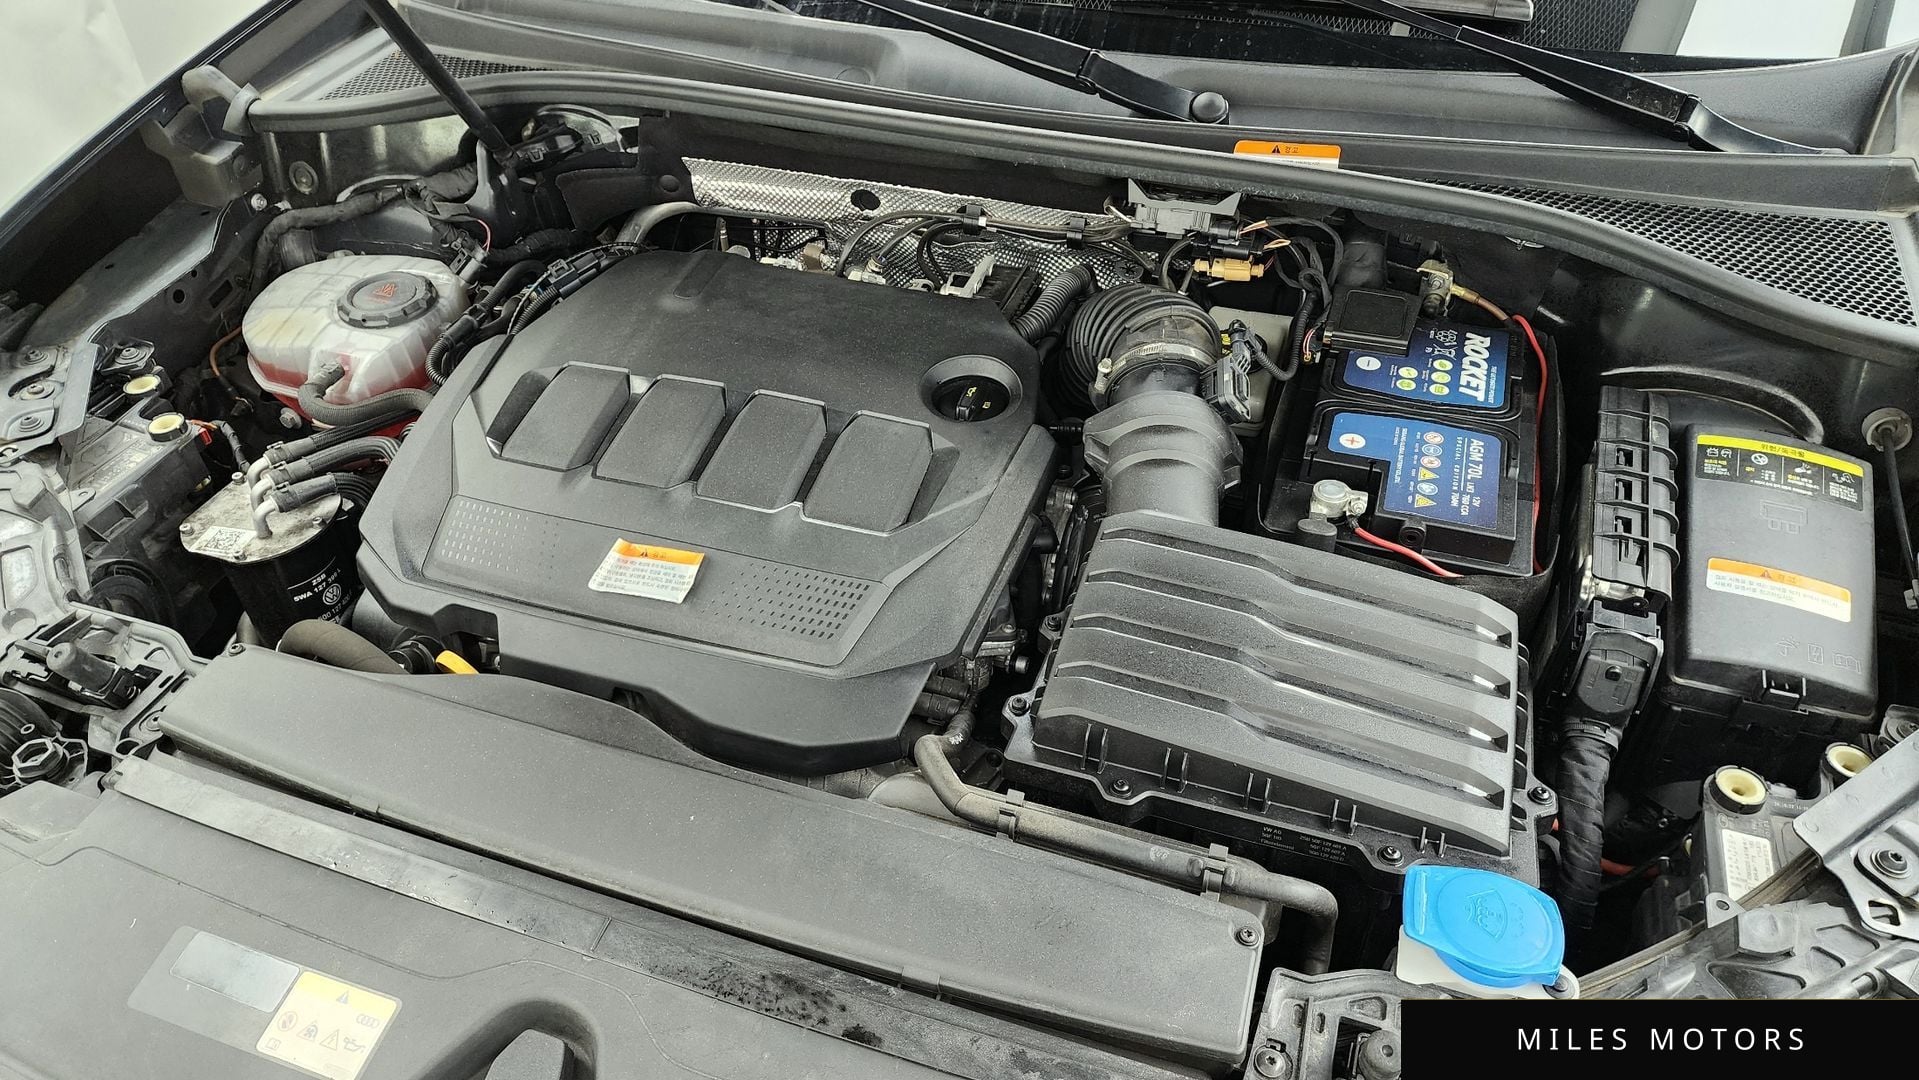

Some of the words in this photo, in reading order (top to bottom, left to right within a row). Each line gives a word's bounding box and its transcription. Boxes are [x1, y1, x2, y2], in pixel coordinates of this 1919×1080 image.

[1458, 332, 1491, 402] ROCKET
[1454, 436, 1463, 461] SPECIAL
[1468, 438, 1484, 462] AGM
[1452, 464, 1461, 491] EDITION
[1467, 463, 1483, 480] 70L
[1460, 505, 1470, 516] CCA
[1472, 496, 1481, 508] 12V
[311, 573, 326, 586] ZSB
[293, 590, 313, 602] 5WA
[314, 581, 326, 593] 127
